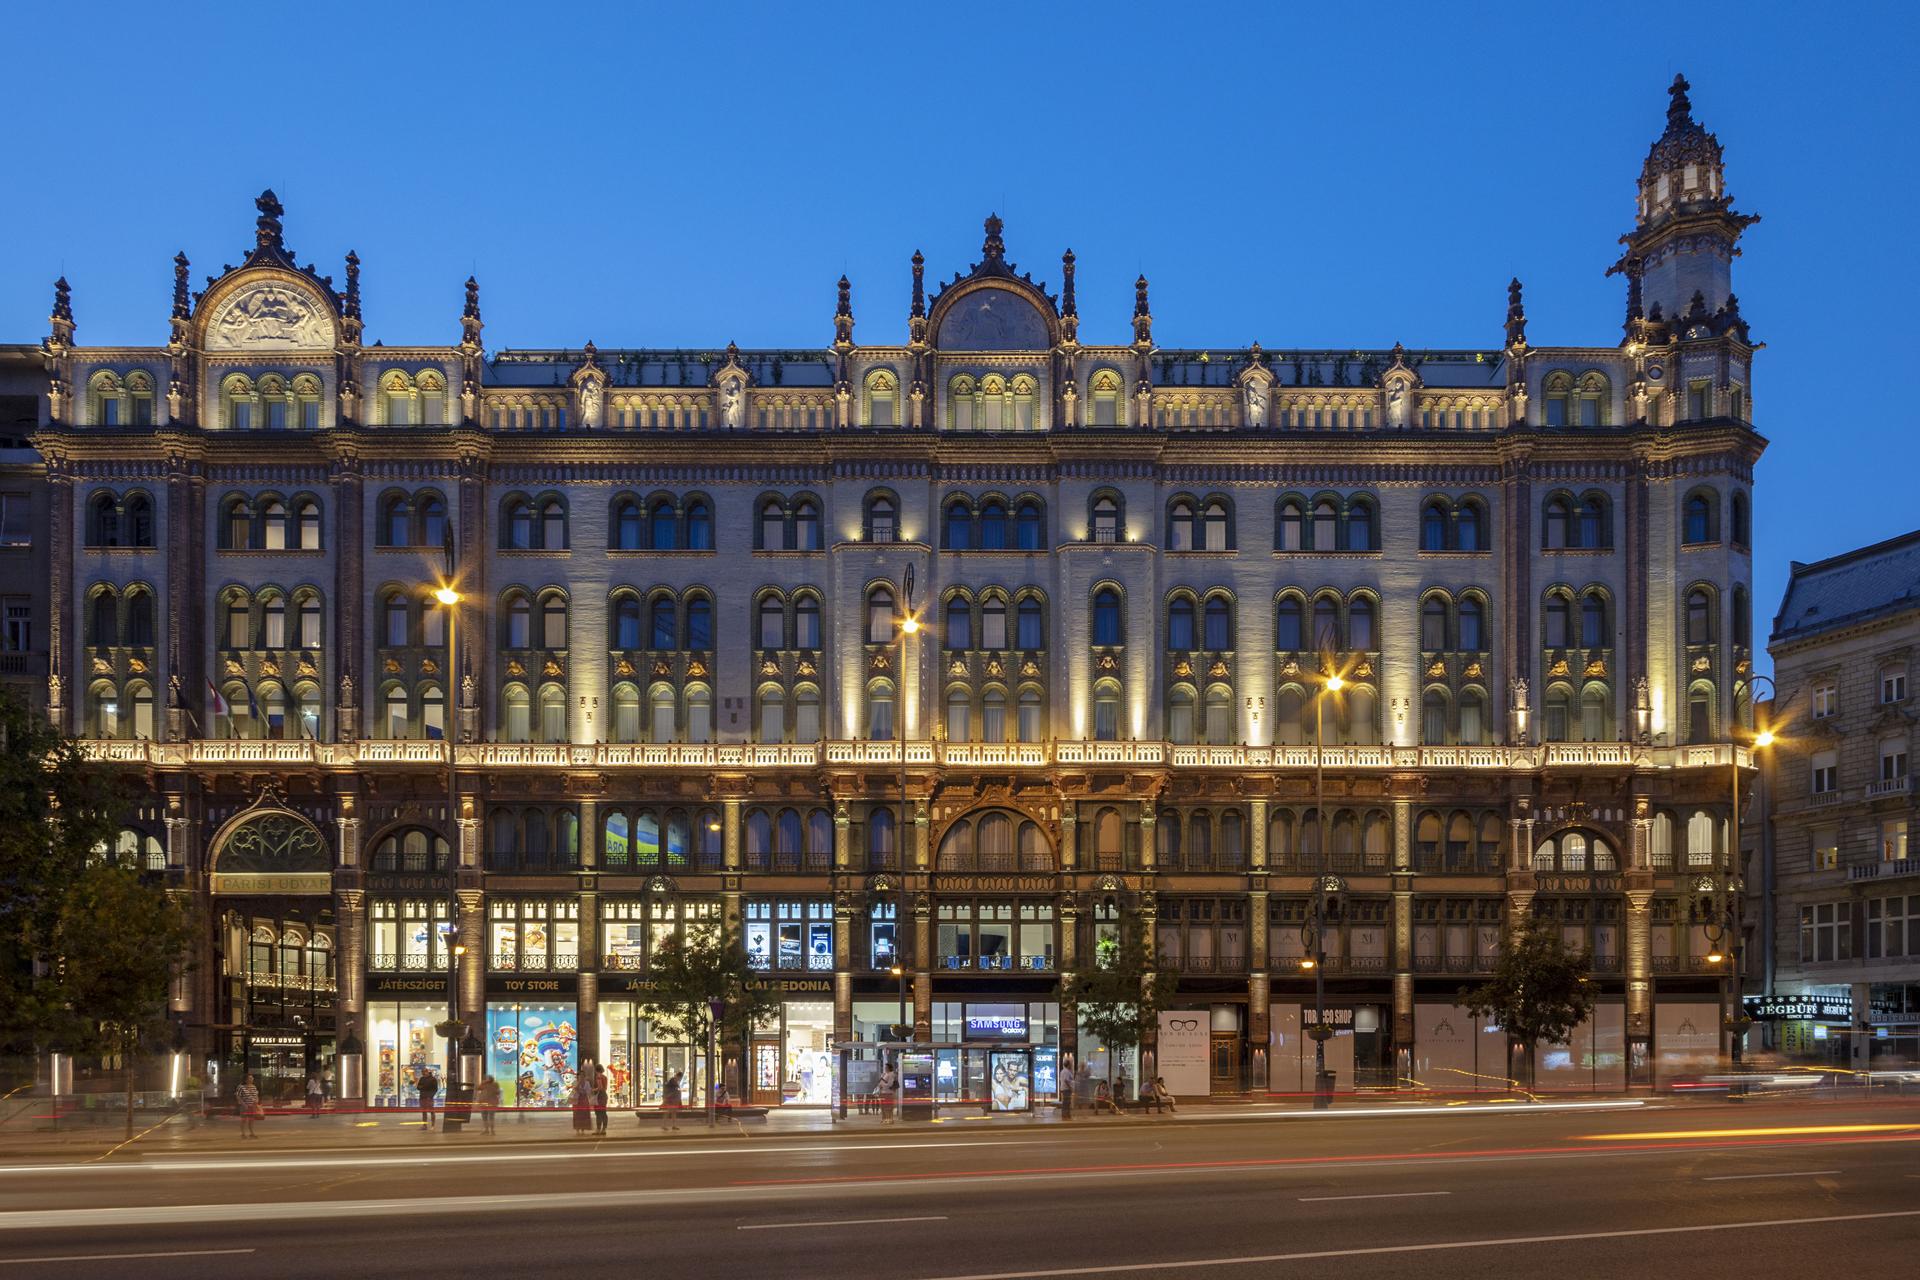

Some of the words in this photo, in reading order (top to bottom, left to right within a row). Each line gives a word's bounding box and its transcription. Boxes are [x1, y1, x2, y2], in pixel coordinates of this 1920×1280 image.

[505, 981, 525, 990] TOY
[527, 981, 559, 990] STORE
[1757, 1003, 1817, 1015] JÉGBÜFÉ
[1303, 1009, 1334, 1024] TOBCO
[1334, 1009, 1353, 1024] SHOP
[970, 1019, 1020, 1029] SAMSUNG
[1001, 1027, 1026, 1035] Galaxy
